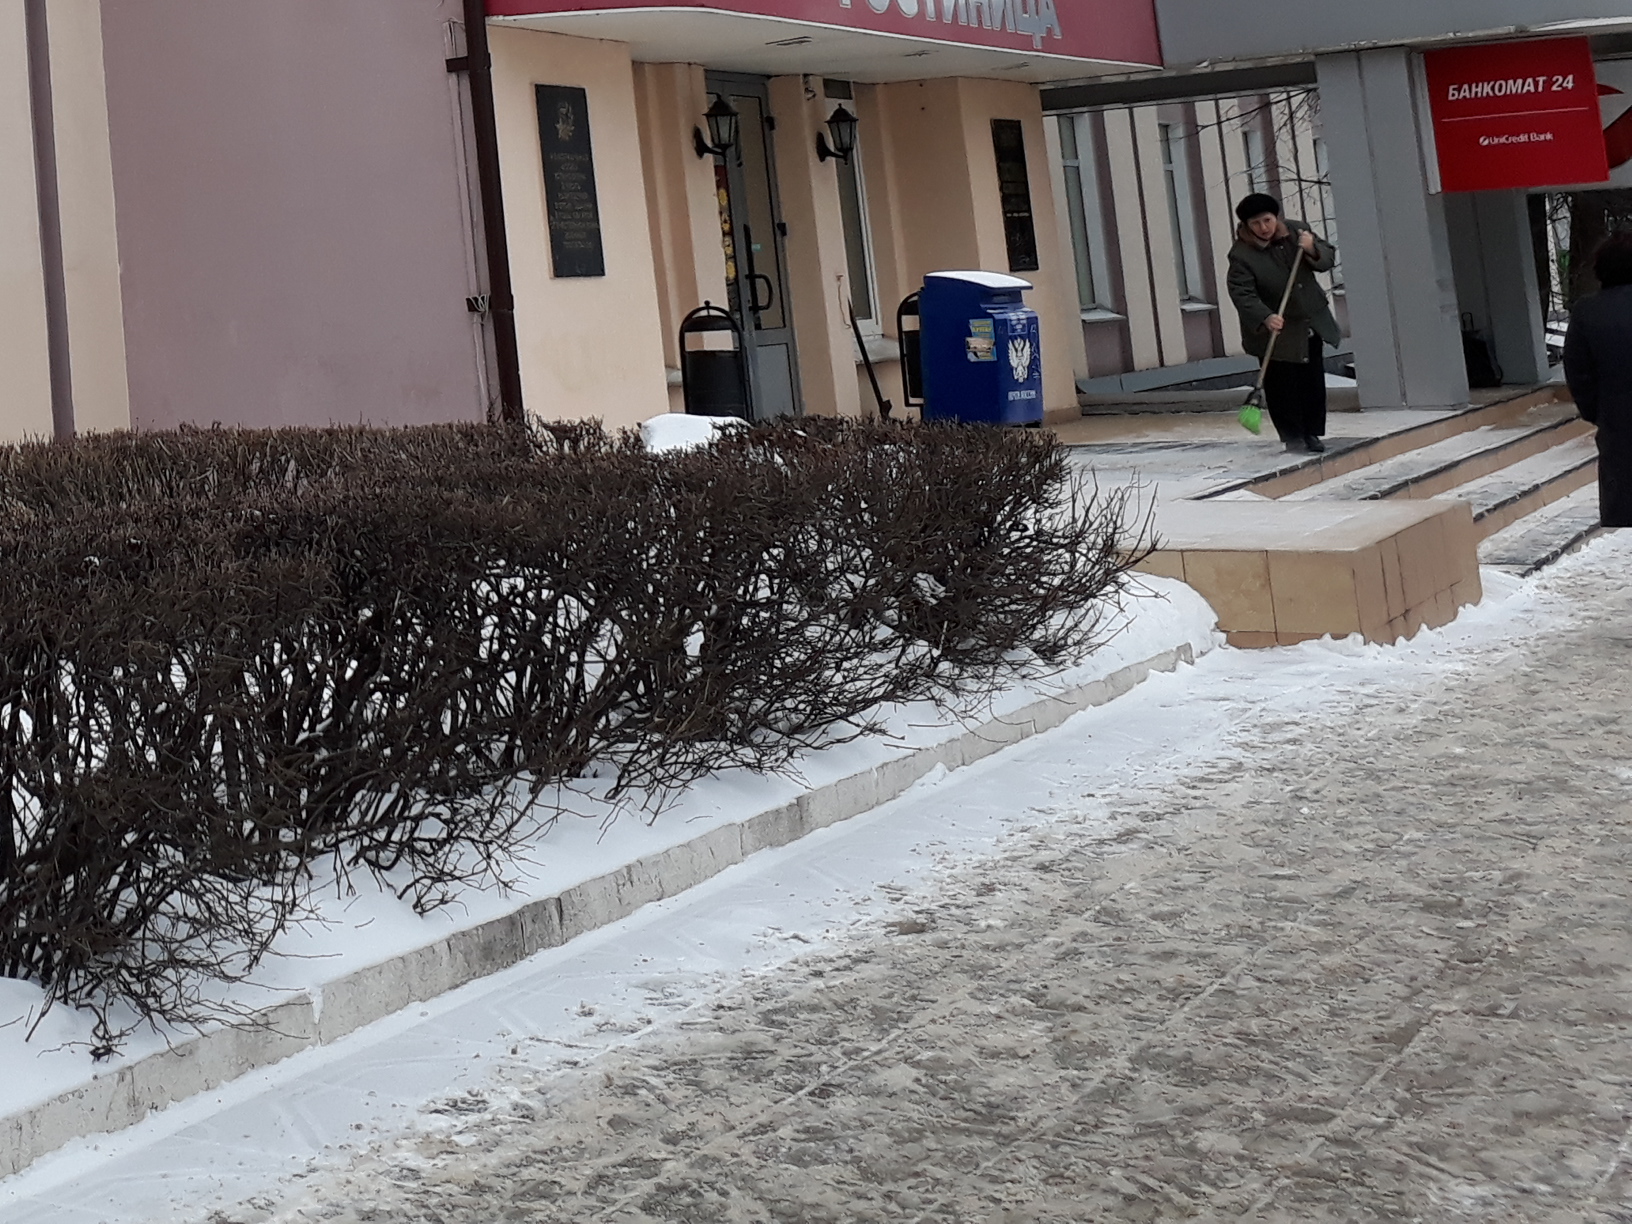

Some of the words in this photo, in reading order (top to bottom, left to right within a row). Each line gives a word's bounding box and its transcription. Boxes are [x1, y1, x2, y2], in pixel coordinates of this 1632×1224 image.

[1448, 76, 1547, 101] БАНКОМАТ
[1551, 74, 1575, 92] 24
[1489, 133, 1529, 145] UniCredit
[1530, 131, 1554, 142] Bank
